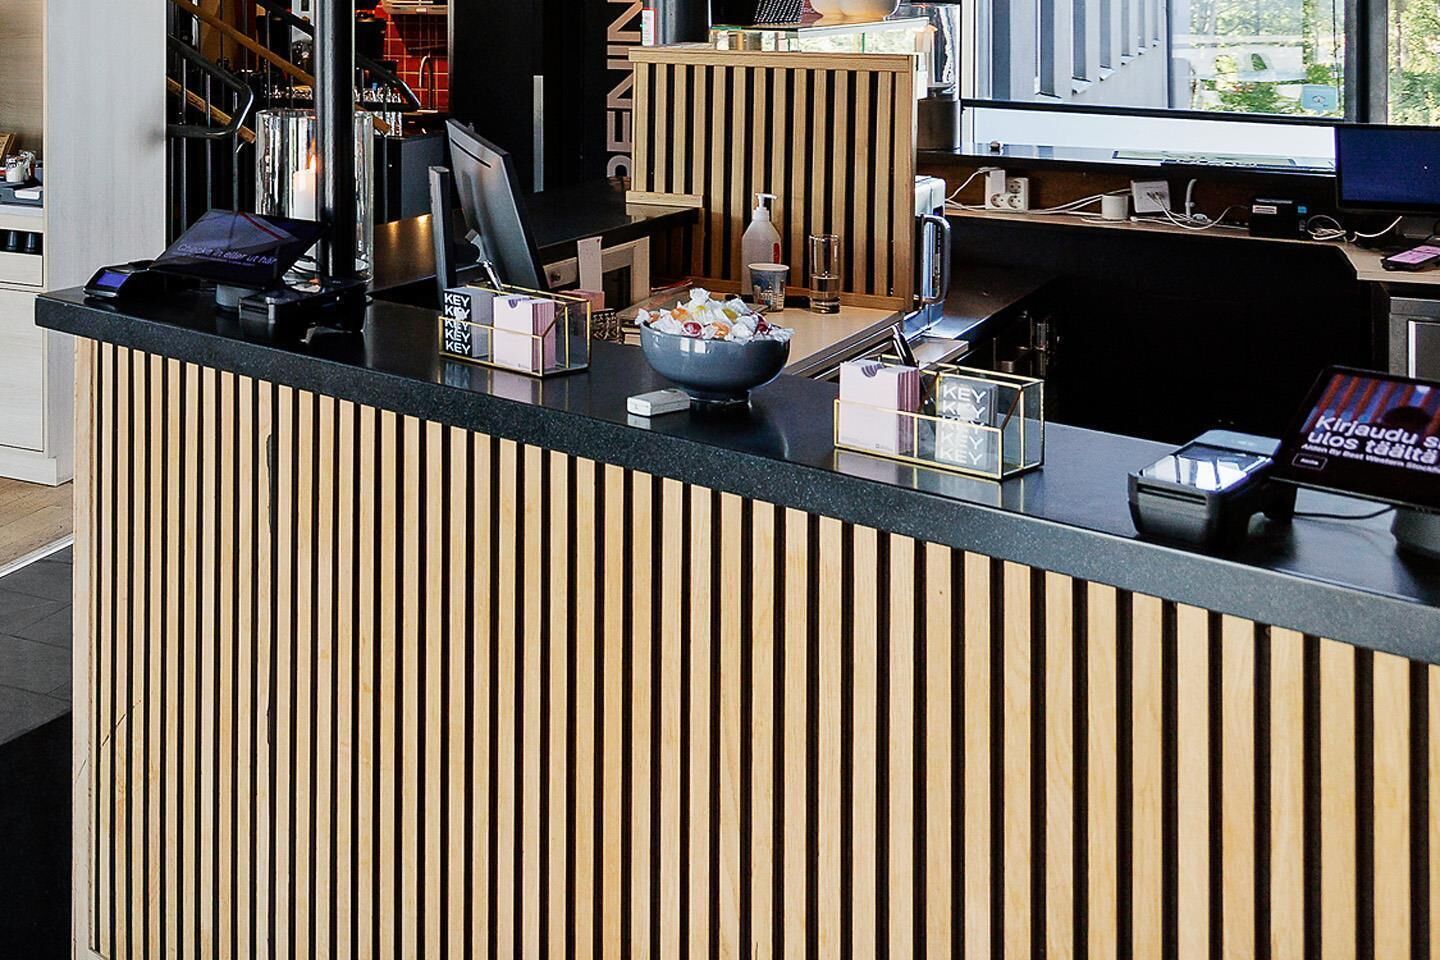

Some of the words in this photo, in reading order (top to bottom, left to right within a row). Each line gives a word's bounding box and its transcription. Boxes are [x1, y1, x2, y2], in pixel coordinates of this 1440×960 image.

[444, 292, 471, 307] KEY
[445, 328, 471, 343] KEY
[446, 340, 471, 355] KEY
[943, 384, 987, 404] KEY
[943, 400, 986, 419] KY
[1315, 415, 1419, 445] Kirjaudu
[1307, 431, 1359, 450] ulos
[1365, 439, 1438, 465] täältä
